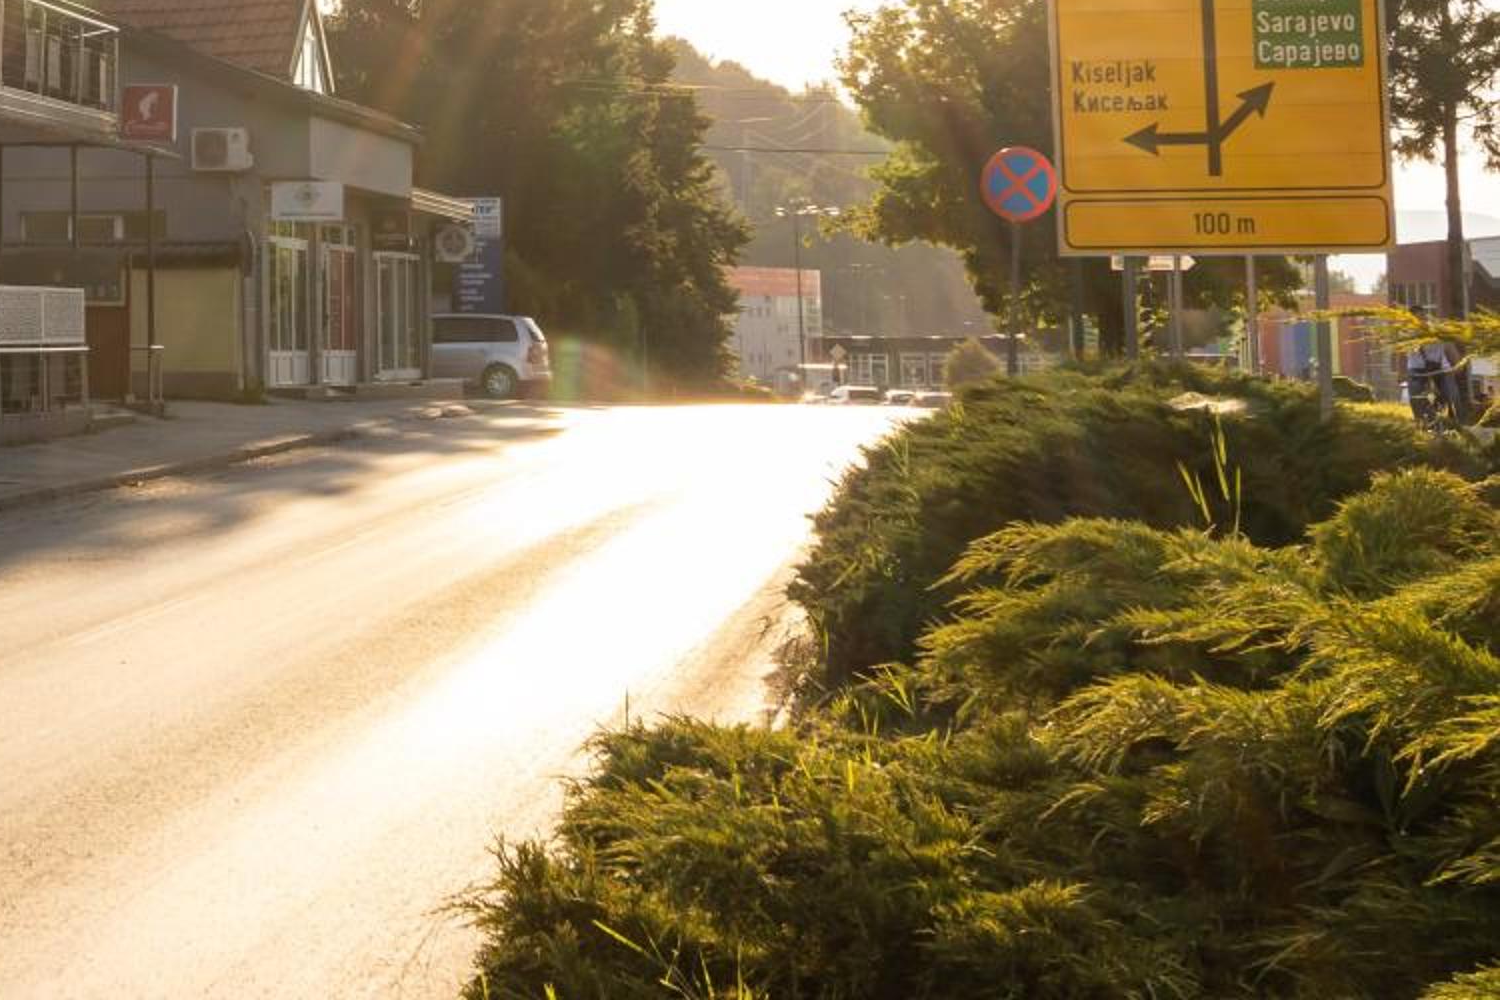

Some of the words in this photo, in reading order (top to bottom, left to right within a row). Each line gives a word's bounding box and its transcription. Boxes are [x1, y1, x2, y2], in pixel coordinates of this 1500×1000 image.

[1257, 10, 1356, 38] Sarajevo
[1258, 40, 1360, 67] Сарајево
[1072, 60, 1156, 88] Kiseljak
[1073, 89, 1169, 113] Кисељак
[1194, 212, 1231, 235] 100
[1237, 216, 1256, 235] m
